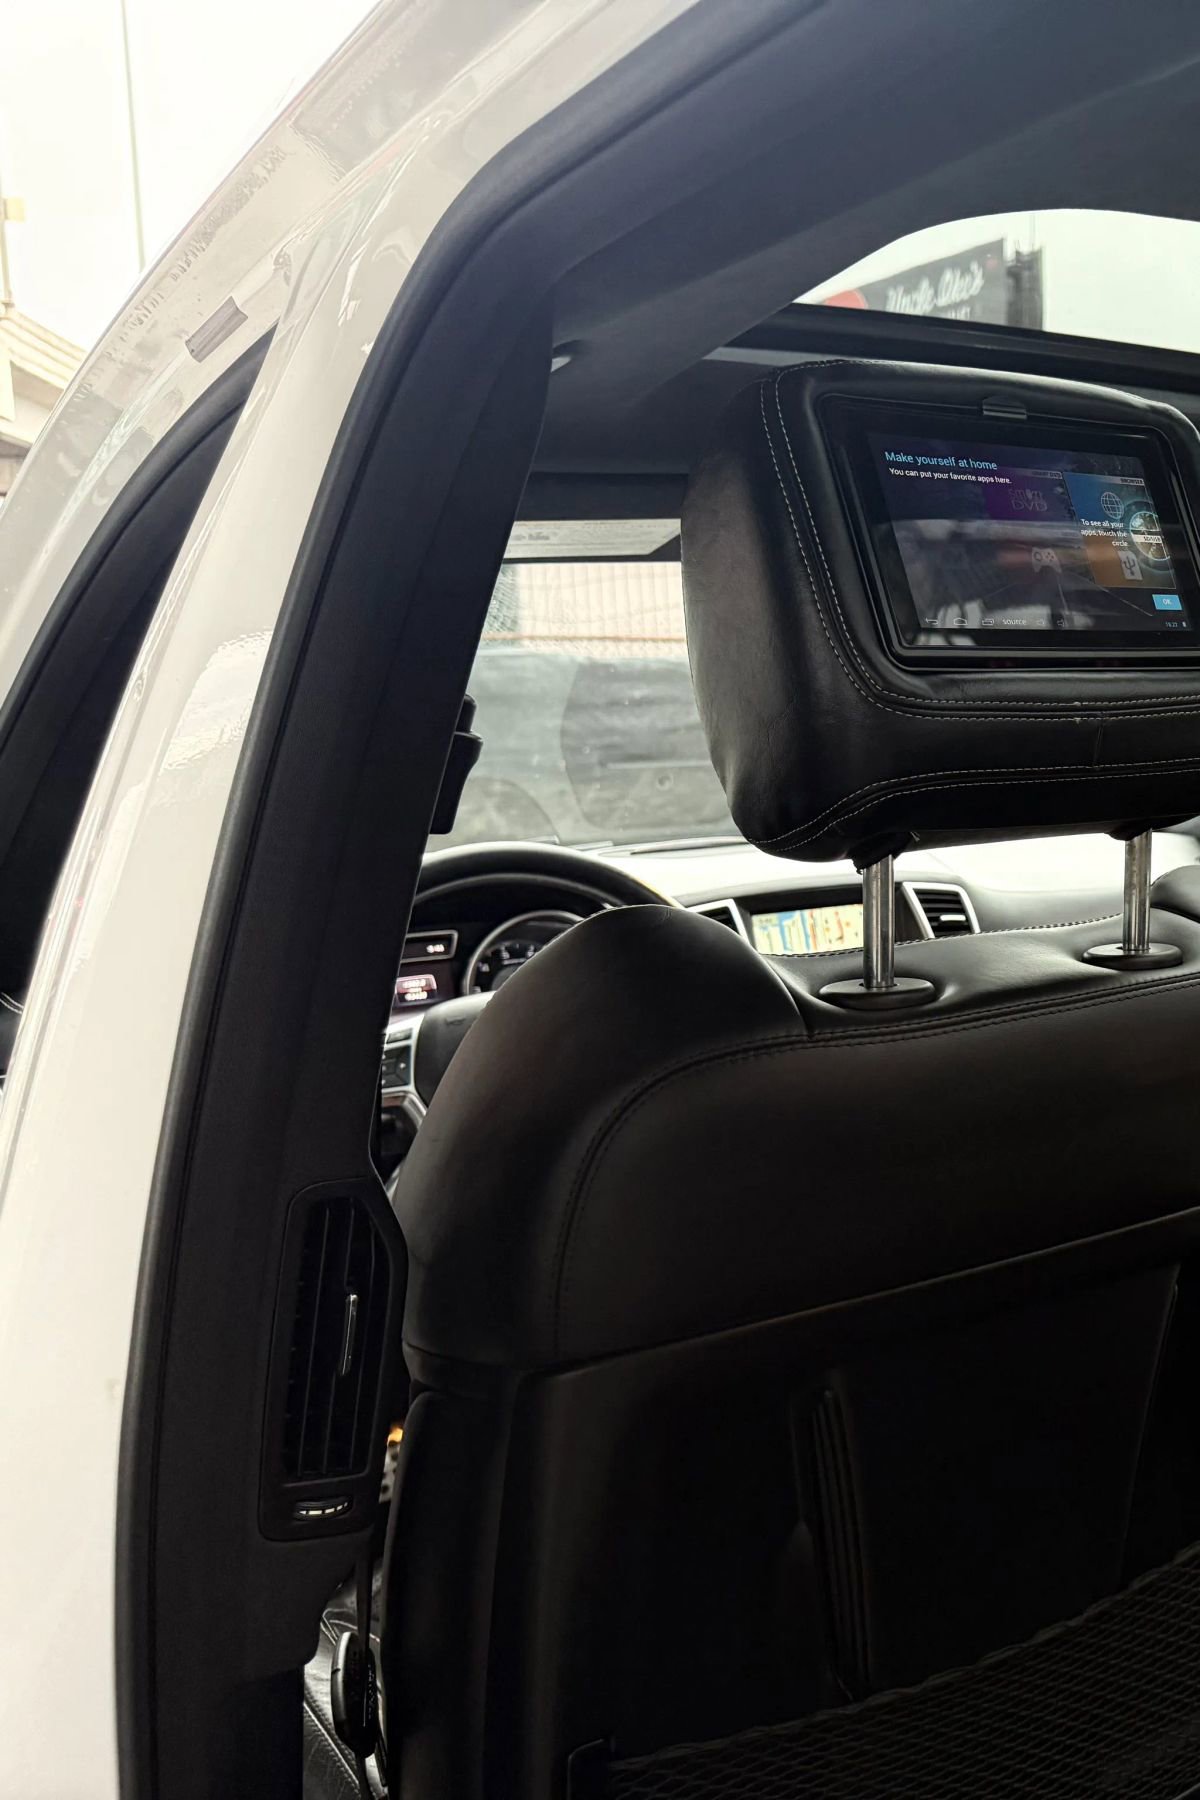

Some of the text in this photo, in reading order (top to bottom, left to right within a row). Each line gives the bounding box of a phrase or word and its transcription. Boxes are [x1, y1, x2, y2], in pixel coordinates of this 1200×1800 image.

[884, 451, 998, 470] Make yourself at home
[889, 467, 1012, 484] You can put your favorite apps here.
[1080, 518, 1089, 526] To
[1080, 529, 1098, 537] apps,
